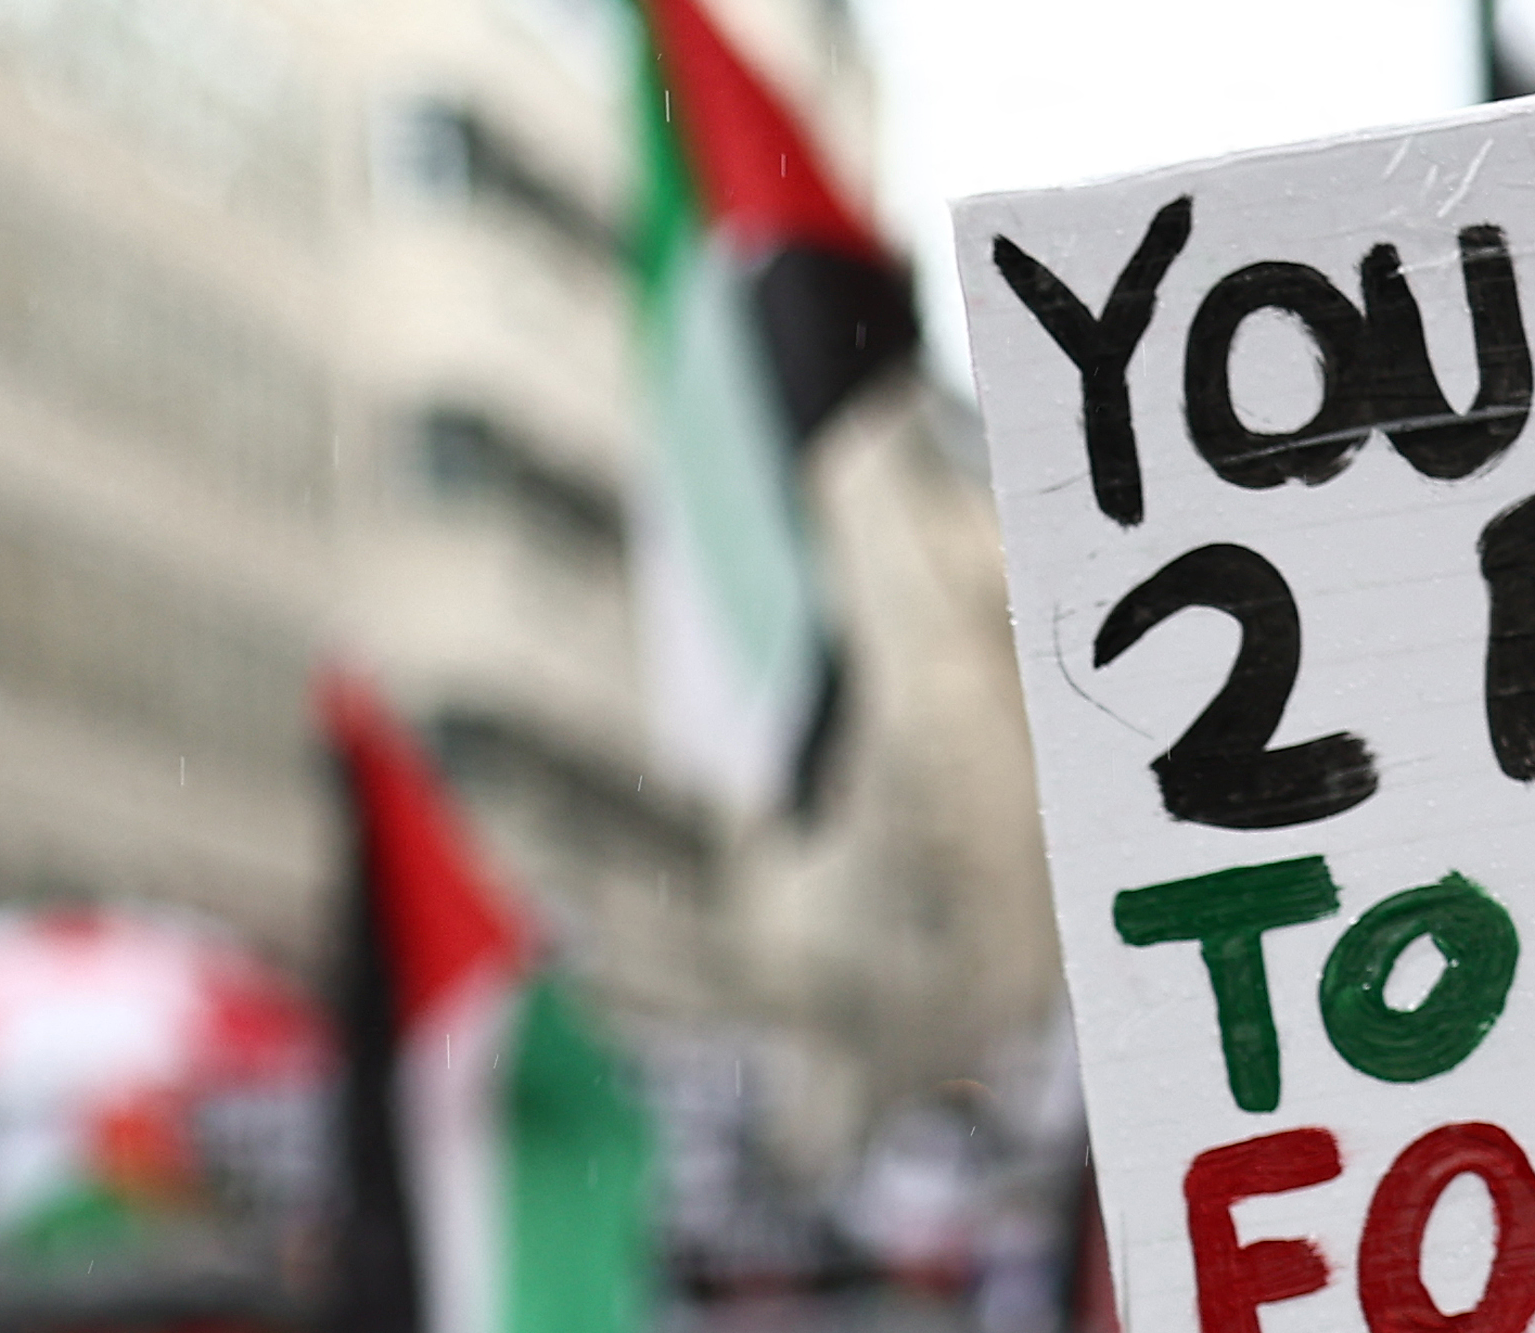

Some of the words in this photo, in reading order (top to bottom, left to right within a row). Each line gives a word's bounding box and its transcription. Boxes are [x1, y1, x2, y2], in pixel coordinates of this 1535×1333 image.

[993, 191, 1535, 527] YOU
[1089, 541, 1380, 831] 2
[1112, 853, 1521, 1114] TO
